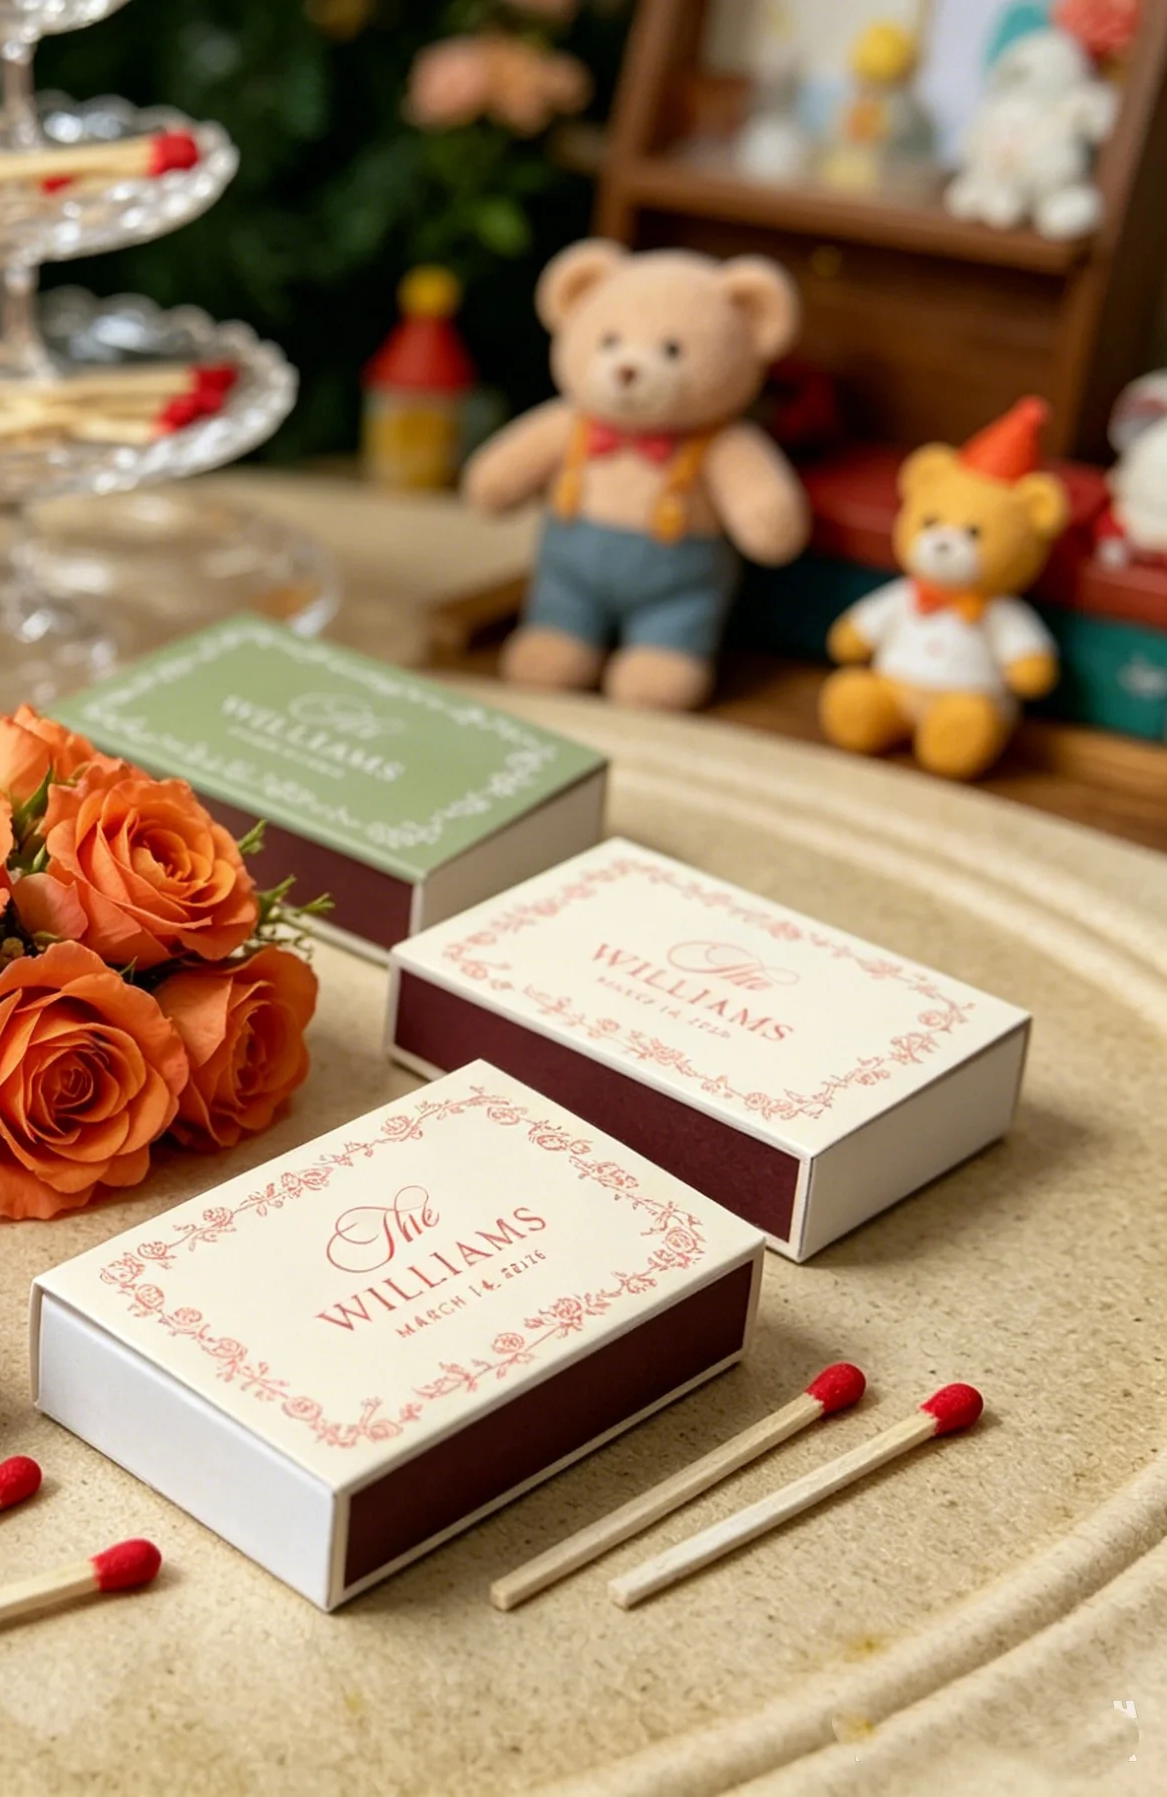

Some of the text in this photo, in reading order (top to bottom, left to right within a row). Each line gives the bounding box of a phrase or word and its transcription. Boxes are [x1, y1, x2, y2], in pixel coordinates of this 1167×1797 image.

[592, 943, 794, 1042] WILLIAMS
[314, 1207, 546, 1331] WILLIAMS
[326, 1185, 440, 1273] The
[395, 1295, 467, 1338] MARCH
